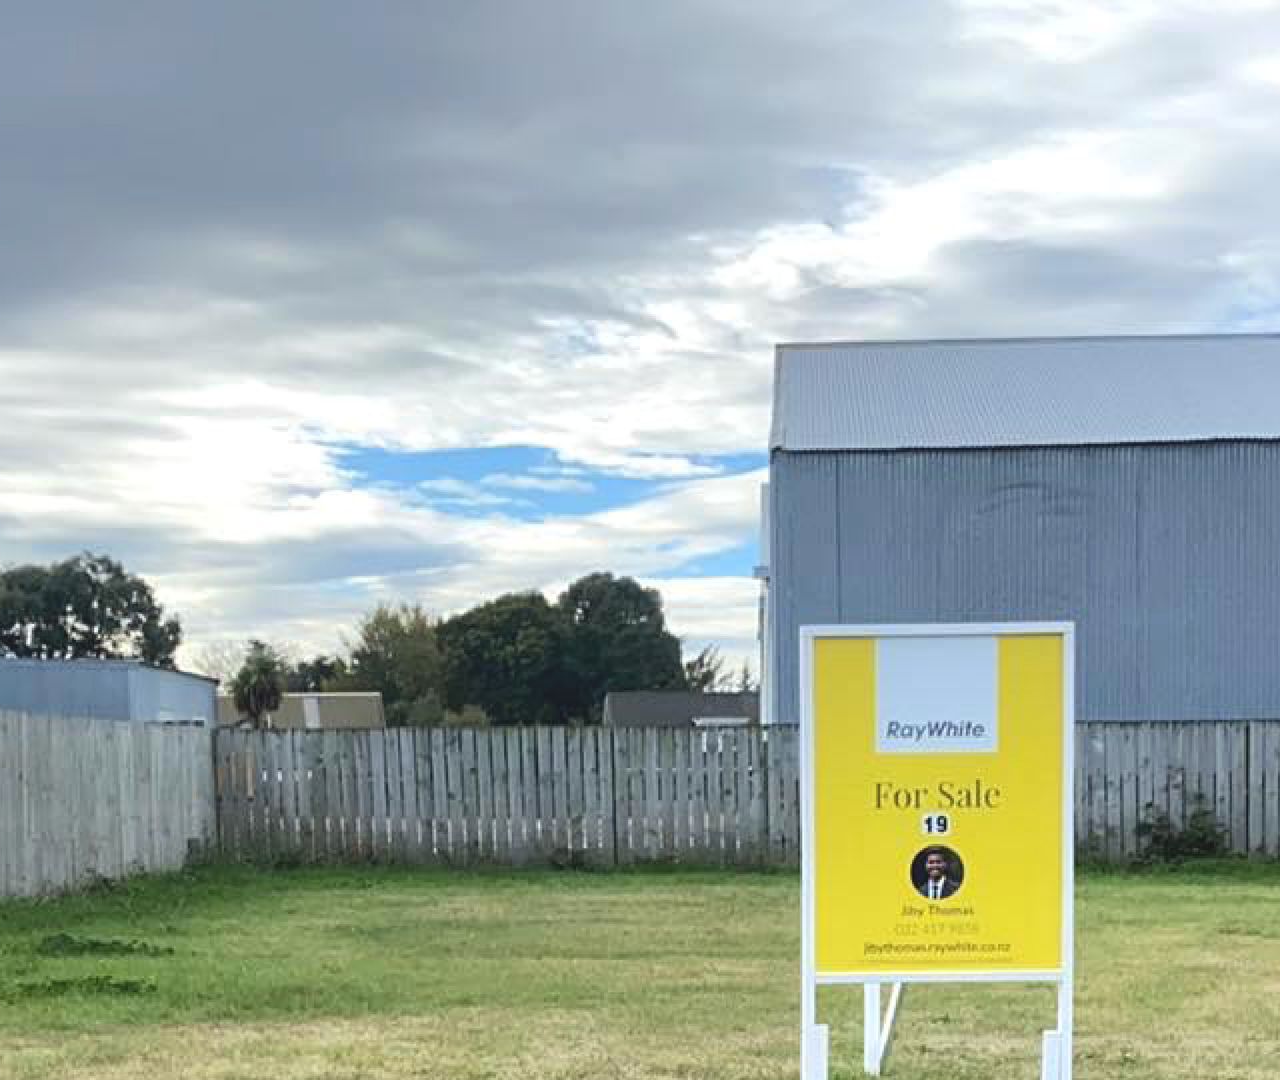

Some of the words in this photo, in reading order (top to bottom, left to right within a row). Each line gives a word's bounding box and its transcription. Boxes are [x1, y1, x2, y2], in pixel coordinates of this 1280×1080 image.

[886, 721, 985, 741] RayWhite
[875, 782, 929, 809] For
[937, 778, 1001, 809] Sale
[924, 815, 948, 832] 19
